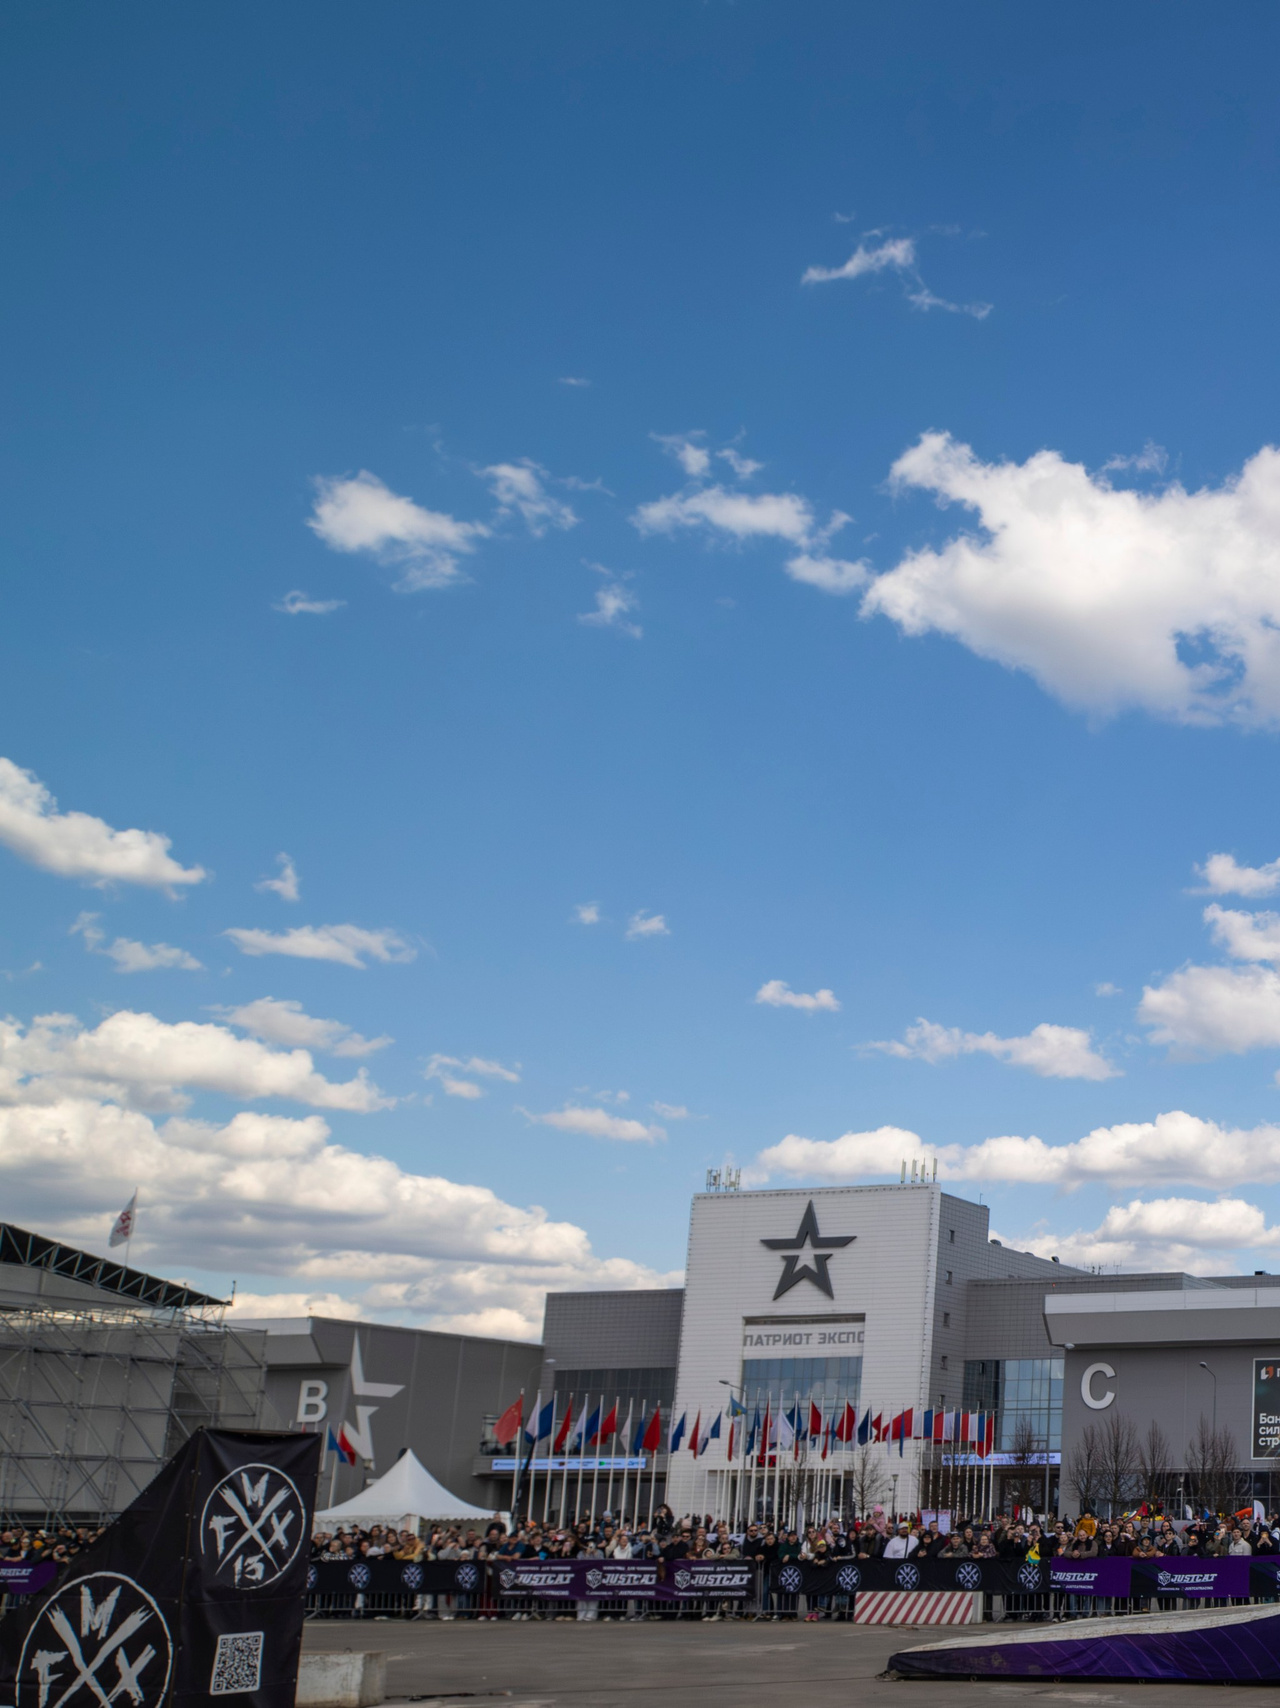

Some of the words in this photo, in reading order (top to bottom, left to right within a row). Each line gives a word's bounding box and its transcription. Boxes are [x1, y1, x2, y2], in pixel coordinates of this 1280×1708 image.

[743, 1333, 813, 1347] ПАТРИОТ
[1080, 1362, 1116, 1410] C
[233, 1552, 266, 1592] 13
[1053, 1572, 1099, 1582] JUSTCAT
[1171, 1573, 1218, 1584] JUSTCAT
[515, 1573, 576, 1587] JUSTCAT
[691, 1573, 752, 1587] JUSTCAT
